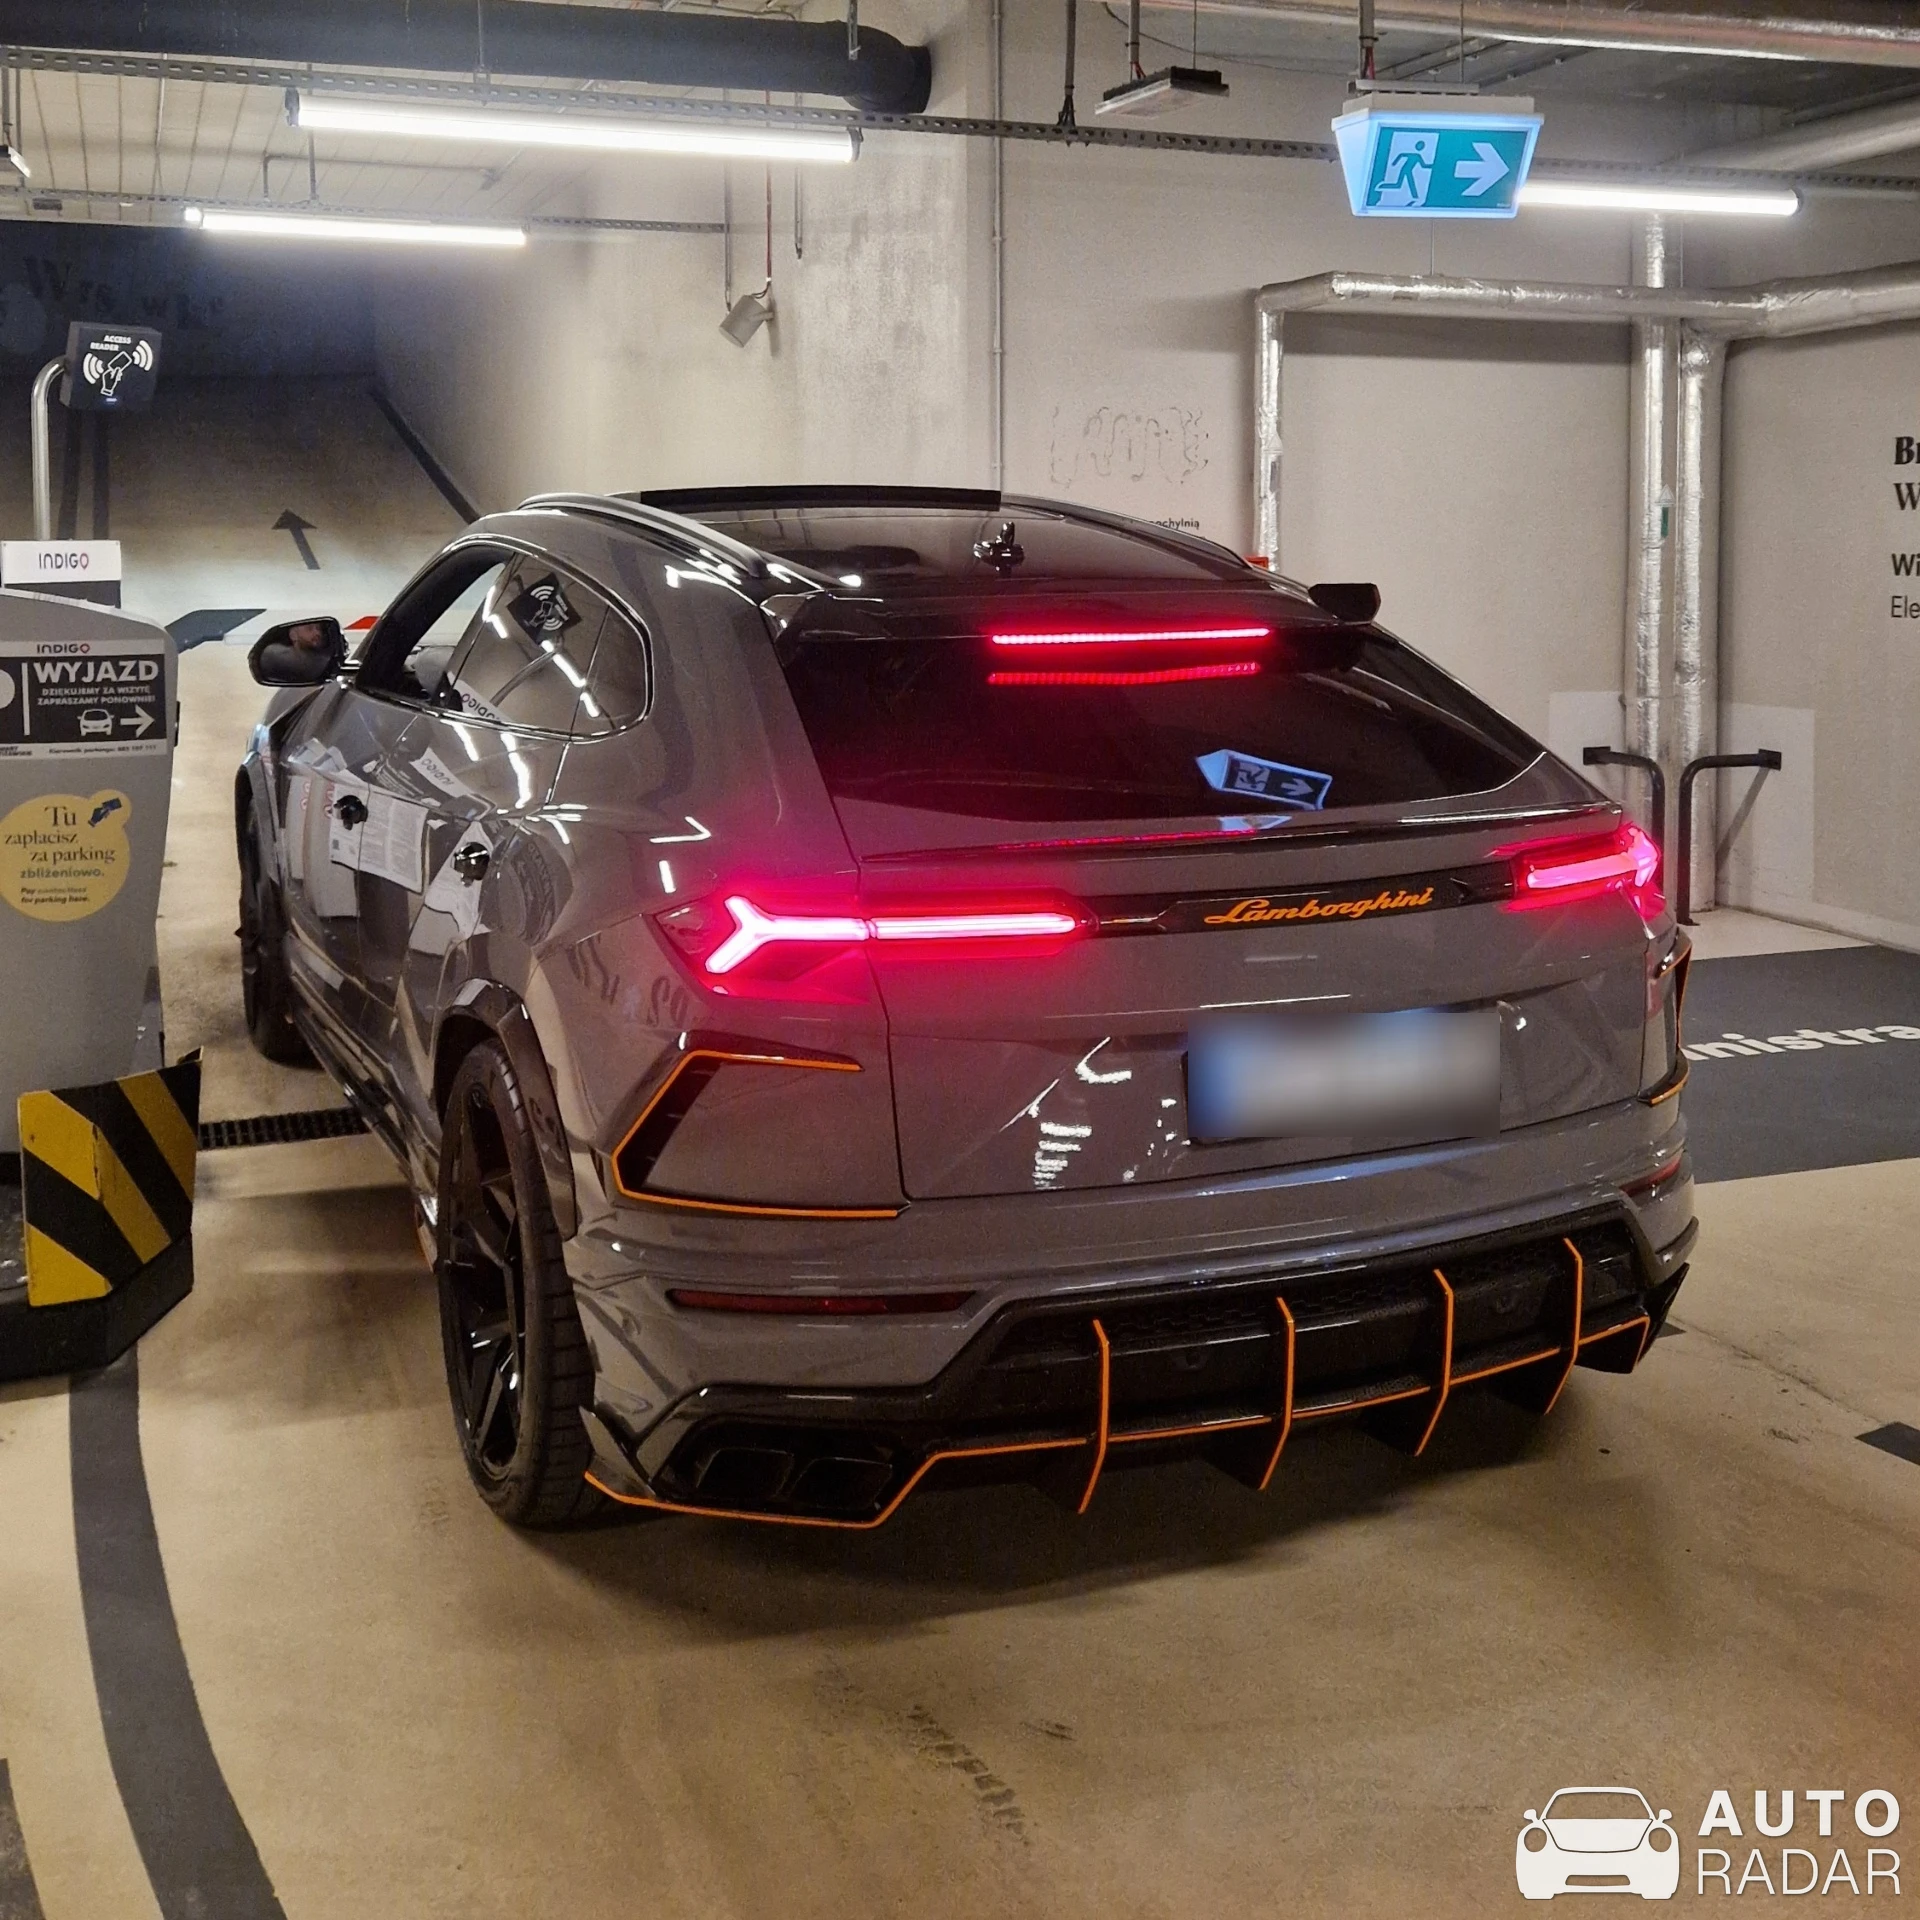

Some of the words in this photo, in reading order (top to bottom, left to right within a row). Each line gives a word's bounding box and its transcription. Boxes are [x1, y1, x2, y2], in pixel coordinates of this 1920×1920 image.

[89, 342, 120, 351] READER
[103, 335, 132, 344] ACCESS
[38, 553, 90, 570] INDIGO
[36, 643, 91, 654] INDIGO
[33, 660, 160, 684] WYJAZD
[102, 687, 116, 695] ZA
[44, 805, 77, 827] Tu
[29, 851, 49, 863] za
[52, 846, 116, 865] parking
[1204, 886, 1434, 924] Lamborghini
[1680, 1024, 1920, 1061] nistra
